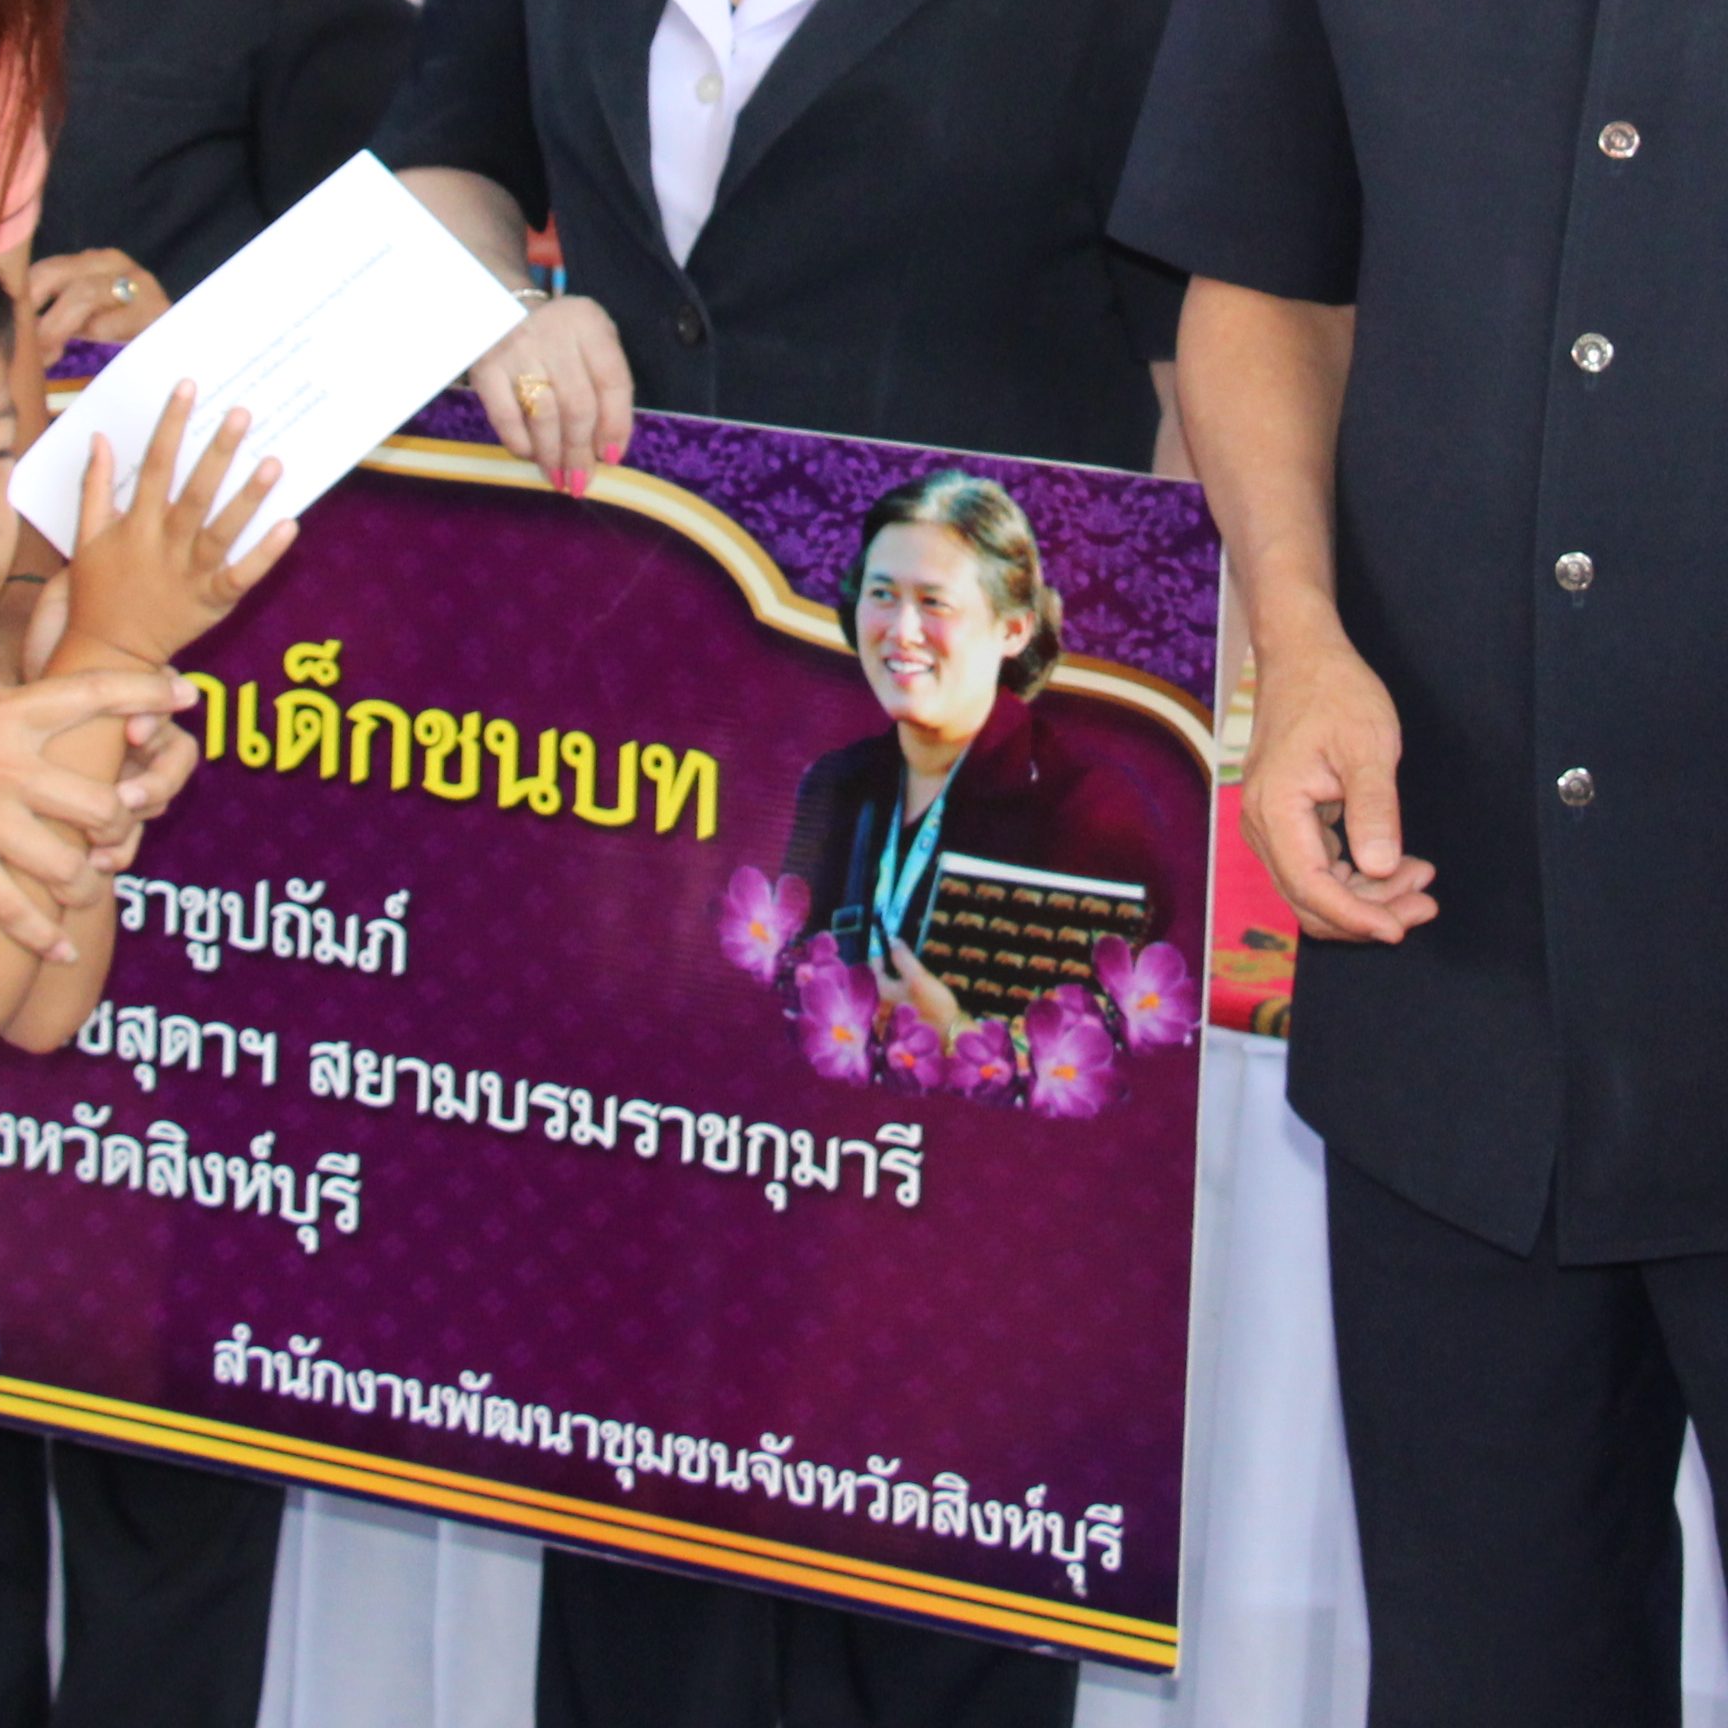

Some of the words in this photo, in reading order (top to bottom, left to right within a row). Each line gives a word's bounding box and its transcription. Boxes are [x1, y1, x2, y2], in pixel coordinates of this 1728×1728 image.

[75, 997, 280, 1094] ชสุดาฯ
[307, 1040, 925, 1210] สยามบรมราชกุมารี
[212, 1322, 1125, 1598] สำนักงานพัฒนาชุมชนจังหวัดสิงห์บุรี
